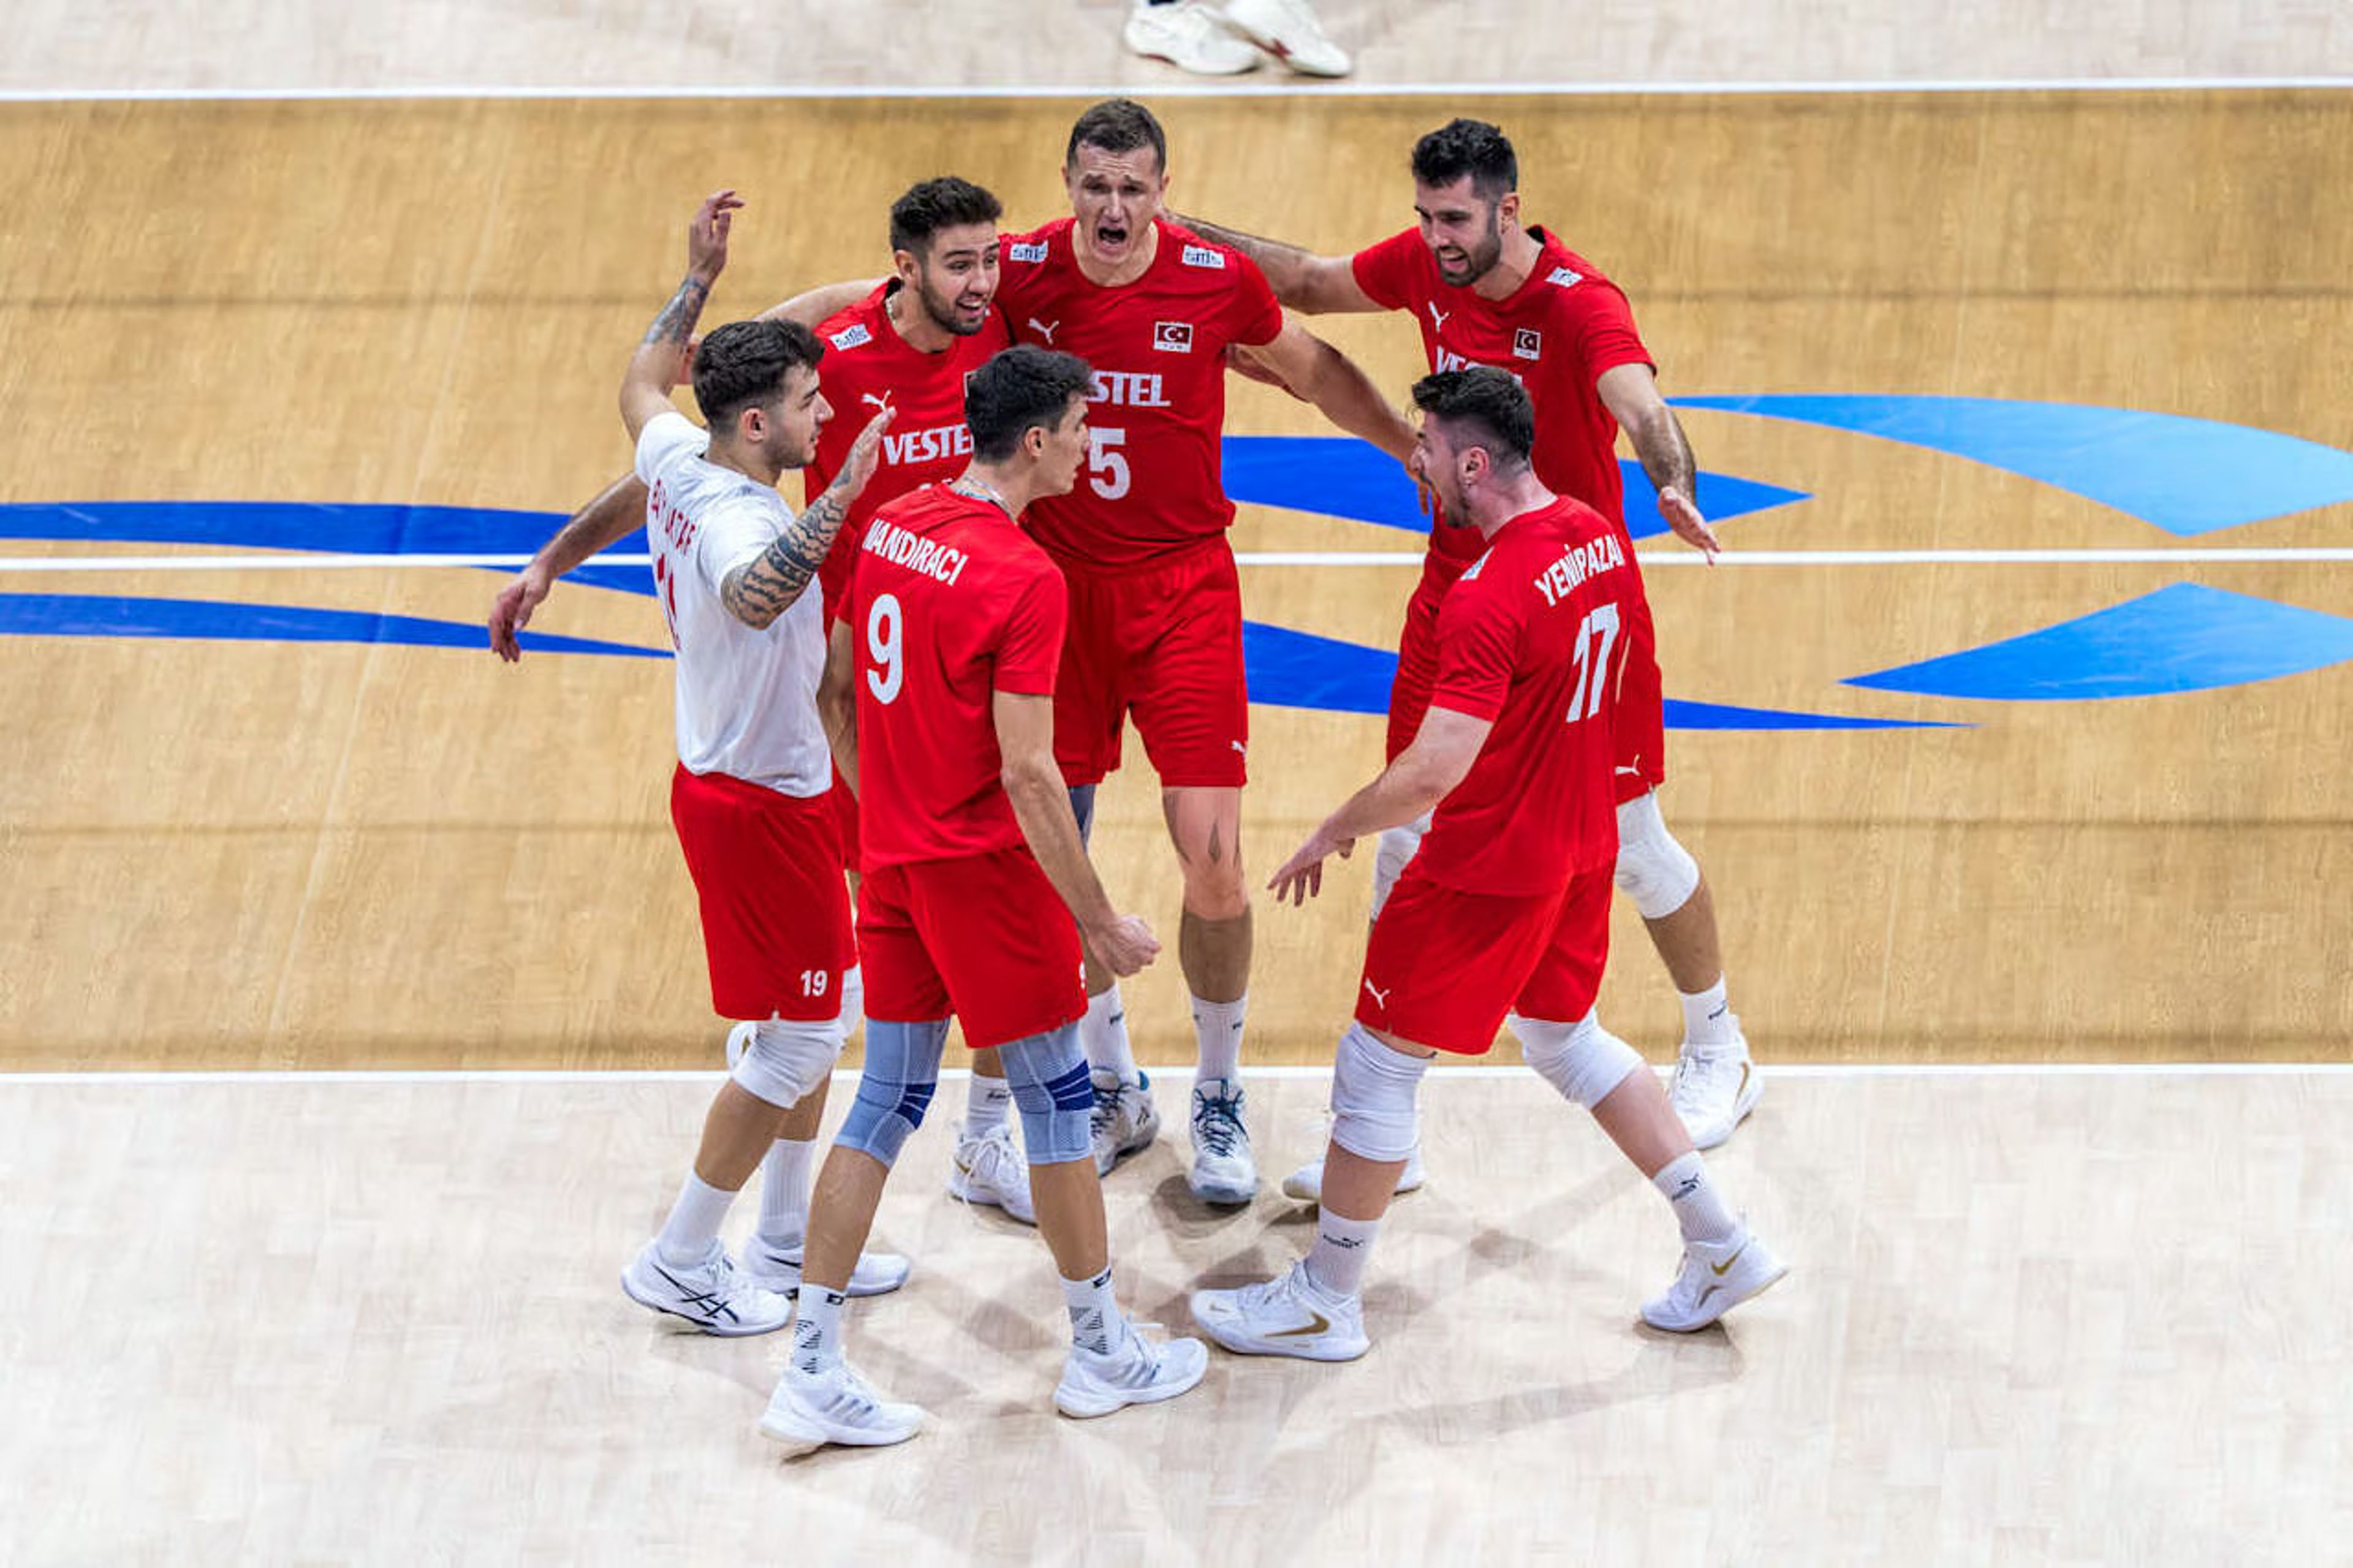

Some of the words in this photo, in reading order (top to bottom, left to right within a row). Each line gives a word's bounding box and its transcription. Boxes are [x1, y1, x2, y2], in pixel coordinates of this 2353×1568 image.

[1087, 370, 1172, 406] STEL
[883, 423, 975, 466] VESTE
[1088, 427, 1131, 501] 5
[867, 593, 903, 705] 9
[1565, 602, 1620, 724] 17
[800, 970, 828, 997] 19
